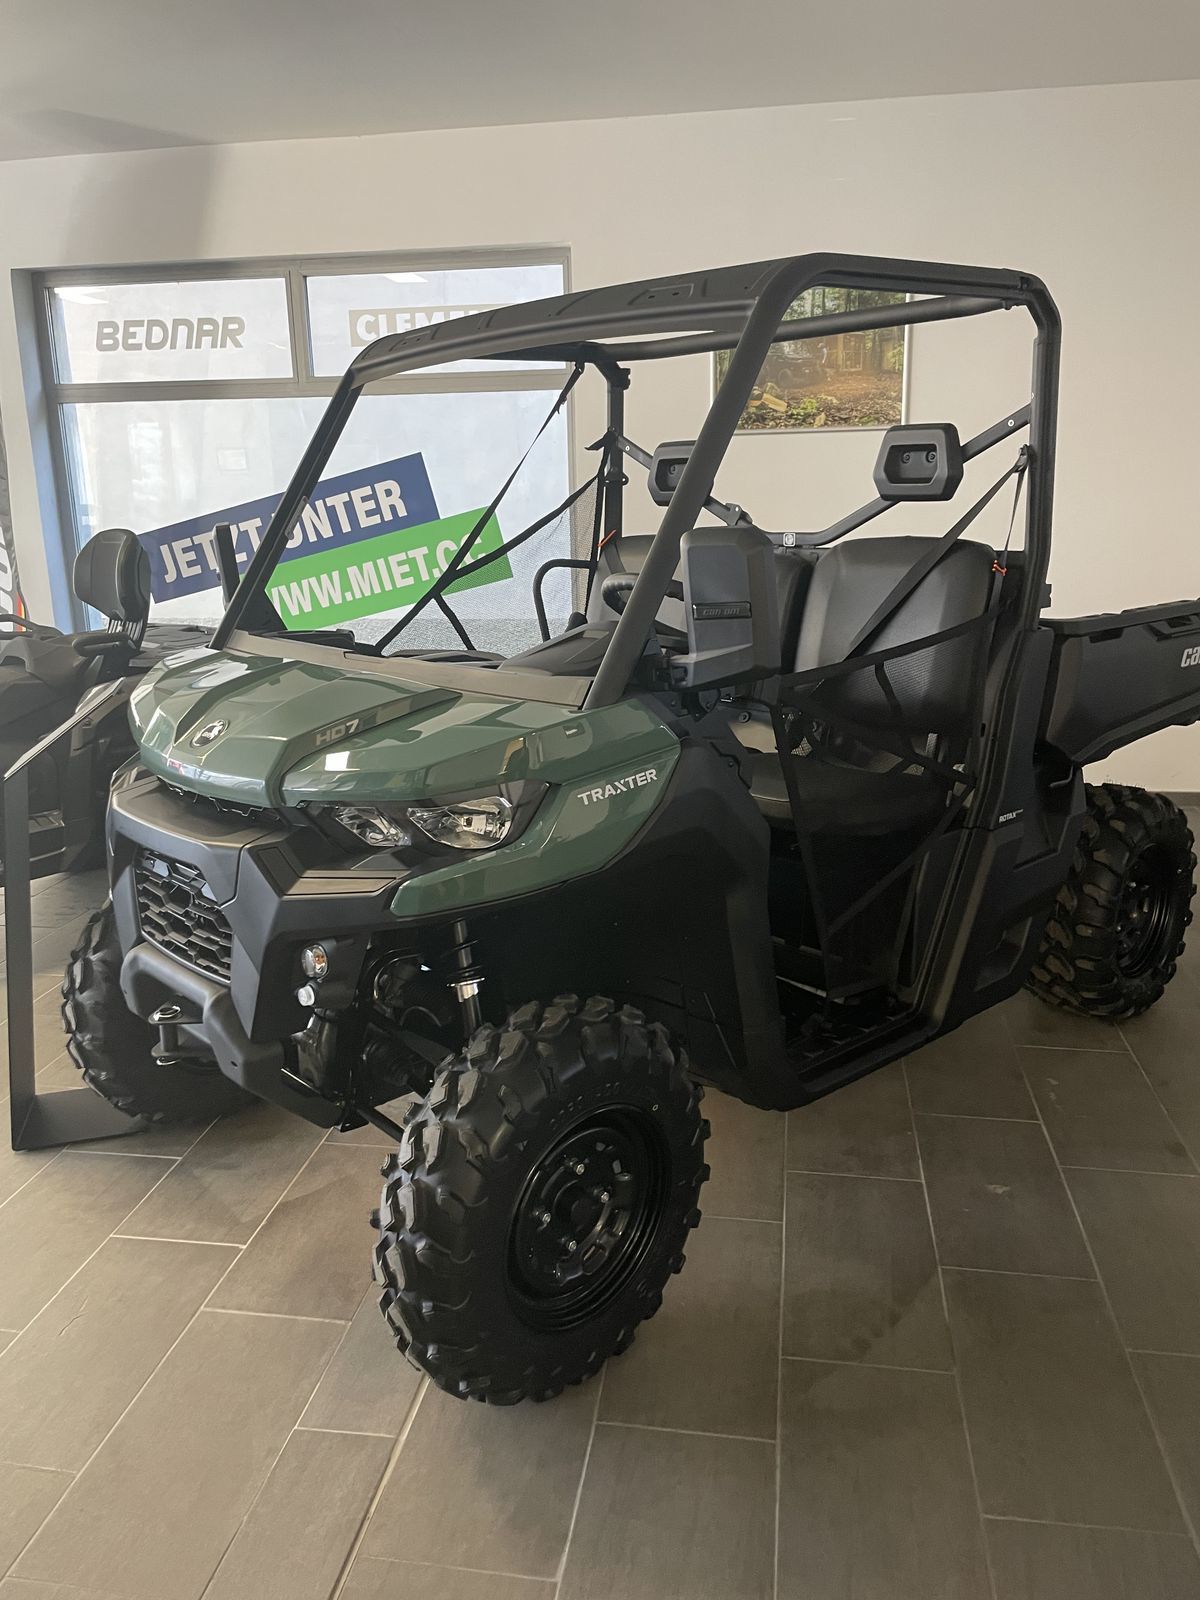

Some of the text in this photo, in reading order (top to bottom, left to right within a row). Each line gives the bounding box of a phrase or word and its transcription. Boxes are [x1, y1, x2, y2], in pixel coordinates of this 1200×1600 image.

[96, 316, 246, 352] BEDNAR
[271, 533, 487, 616] WW.MIET.C
[315, 718, 360, 746] HD7
[577, 768, 658, 806] TRAXTER
